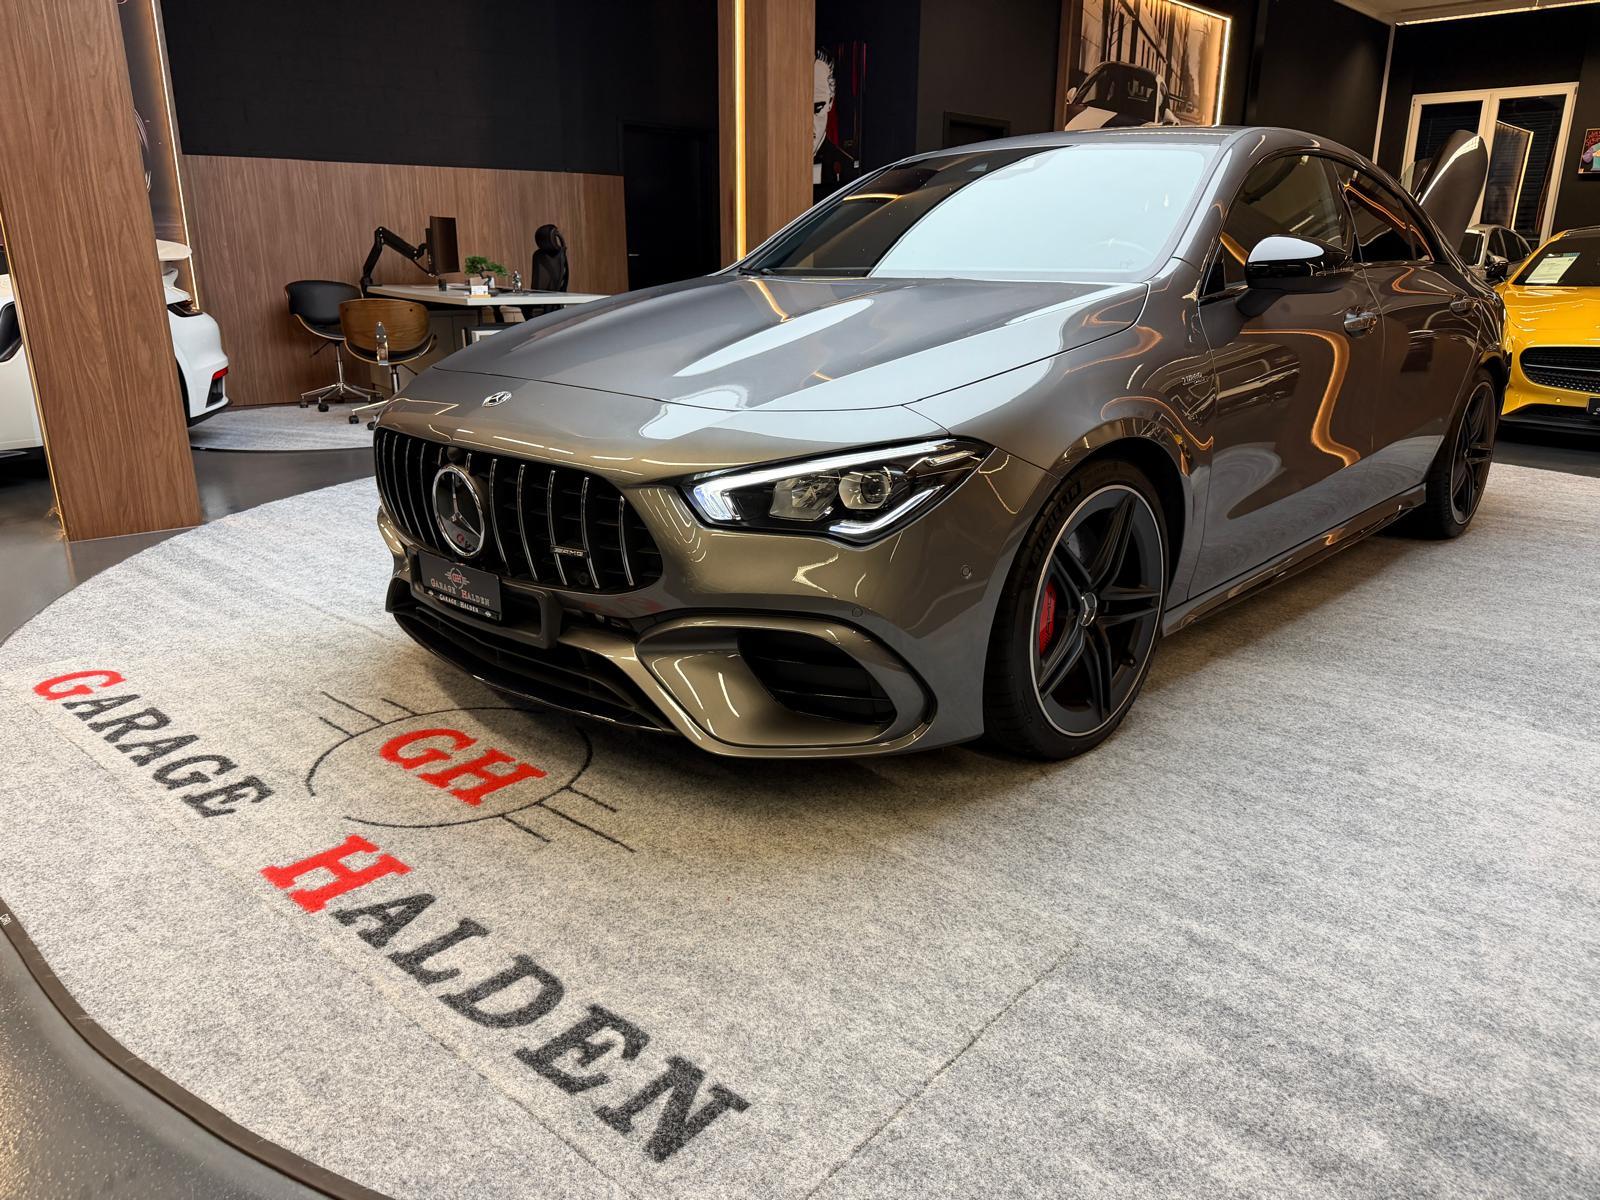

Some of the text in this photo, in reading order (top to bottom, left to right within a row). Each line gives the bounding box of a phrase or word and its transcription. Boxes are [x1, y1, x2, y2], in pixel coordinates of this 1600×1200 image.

[461, 590, 490, 607] HALDEN
[32, 669, 275, 818] GARAGE
[378, 728, 549, 806] GH
[260, 834, 750, 1163] HALDEN
